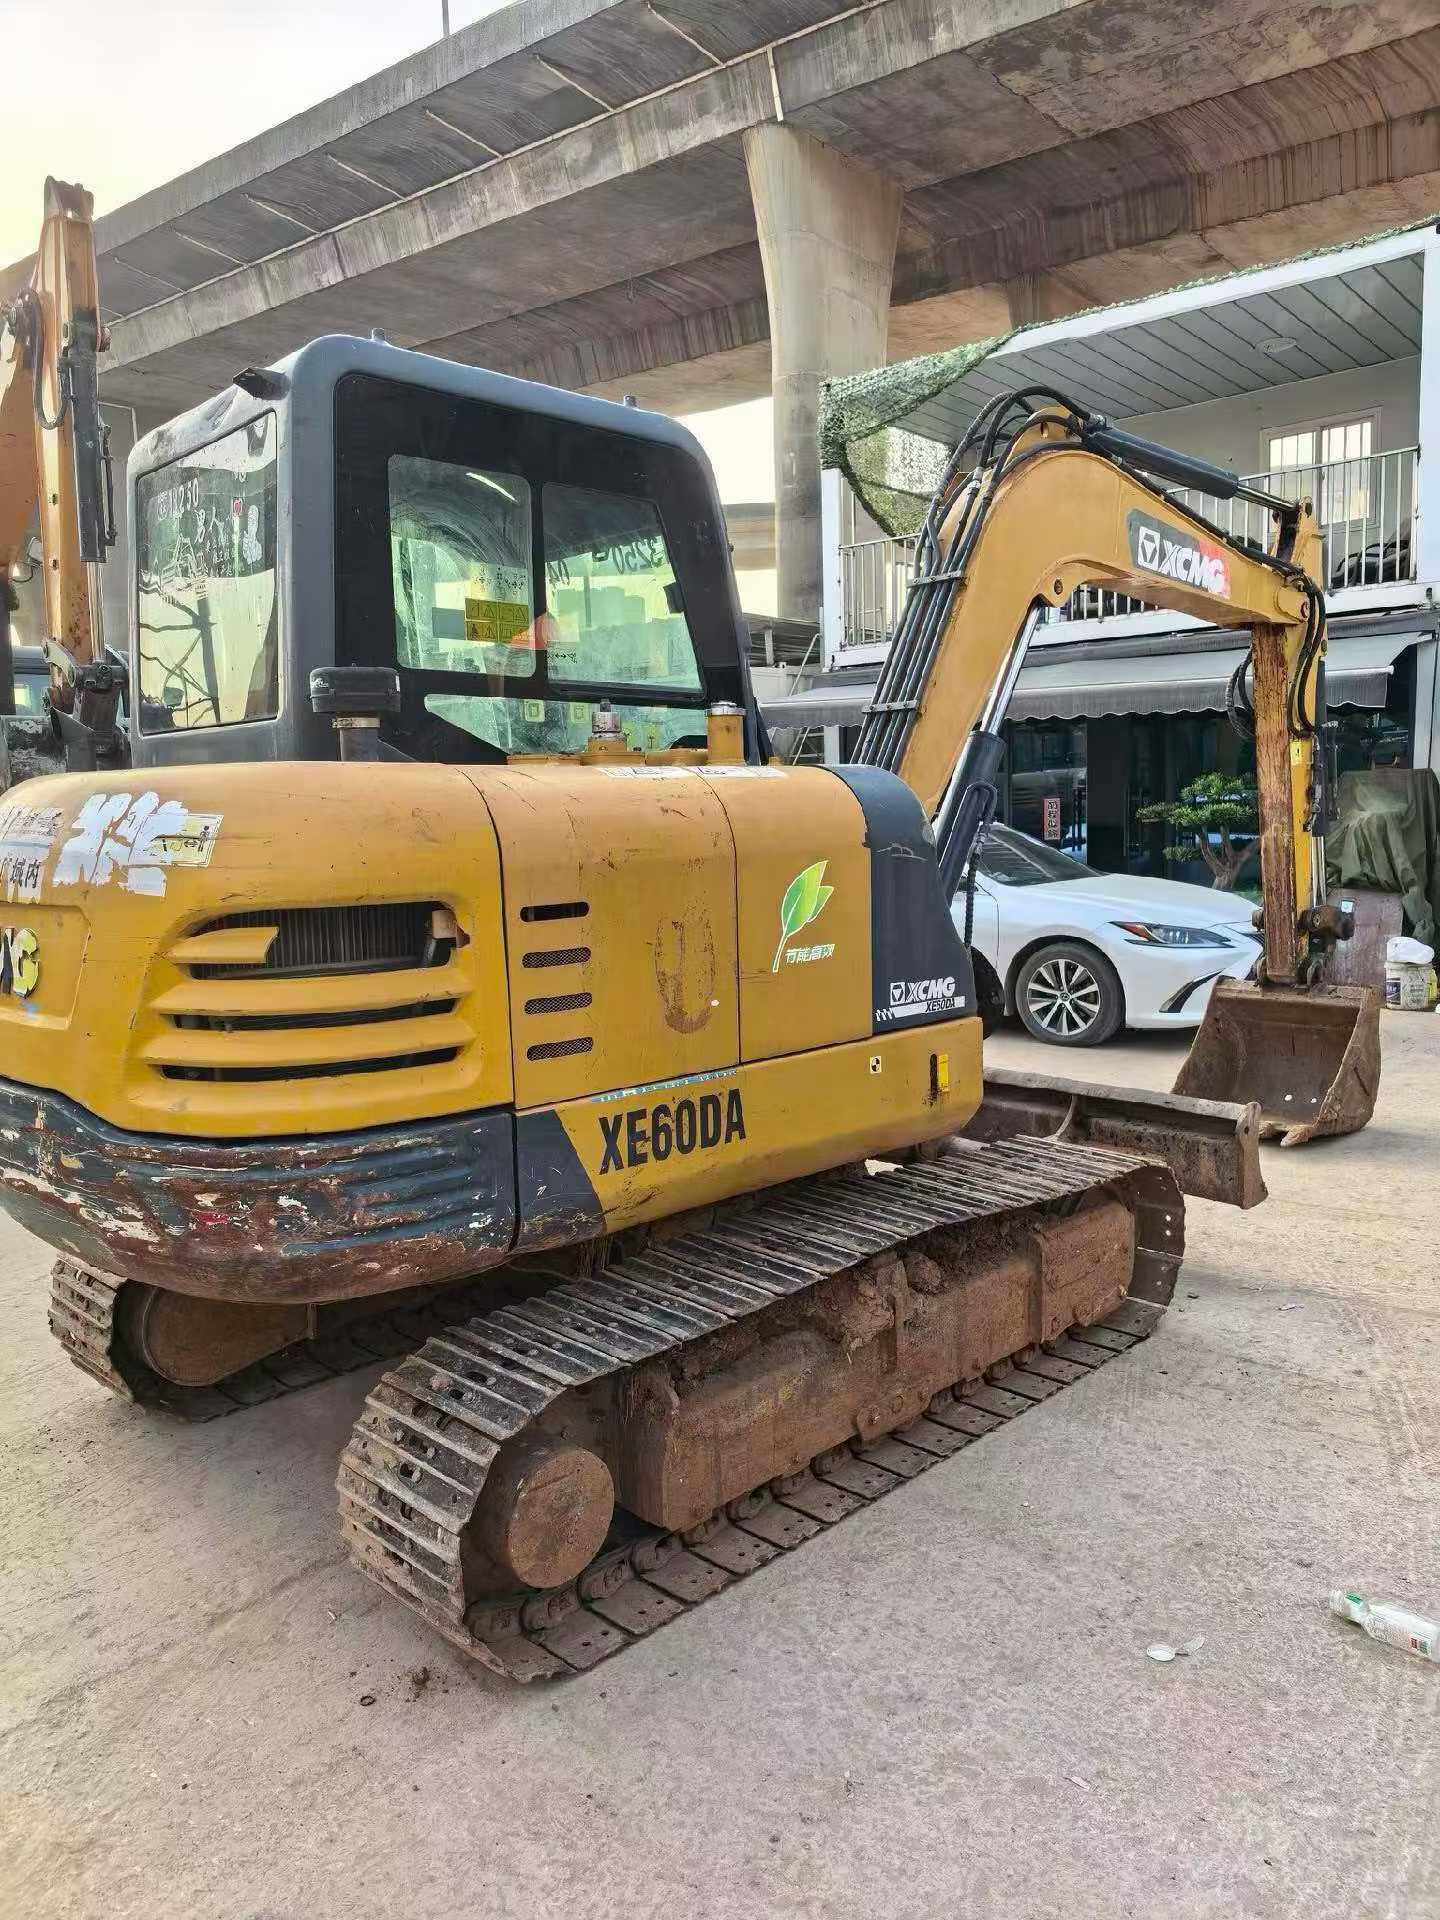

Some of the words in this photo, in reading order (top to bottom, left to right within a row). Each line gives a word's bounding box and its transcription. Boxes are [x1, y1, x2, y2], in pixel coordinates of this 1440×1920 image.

[1159, 539, 1225, 595] XCMG
[905, 976, 956, 1003] XCMG
[598, 1088, 746, 1175] XE60DA
